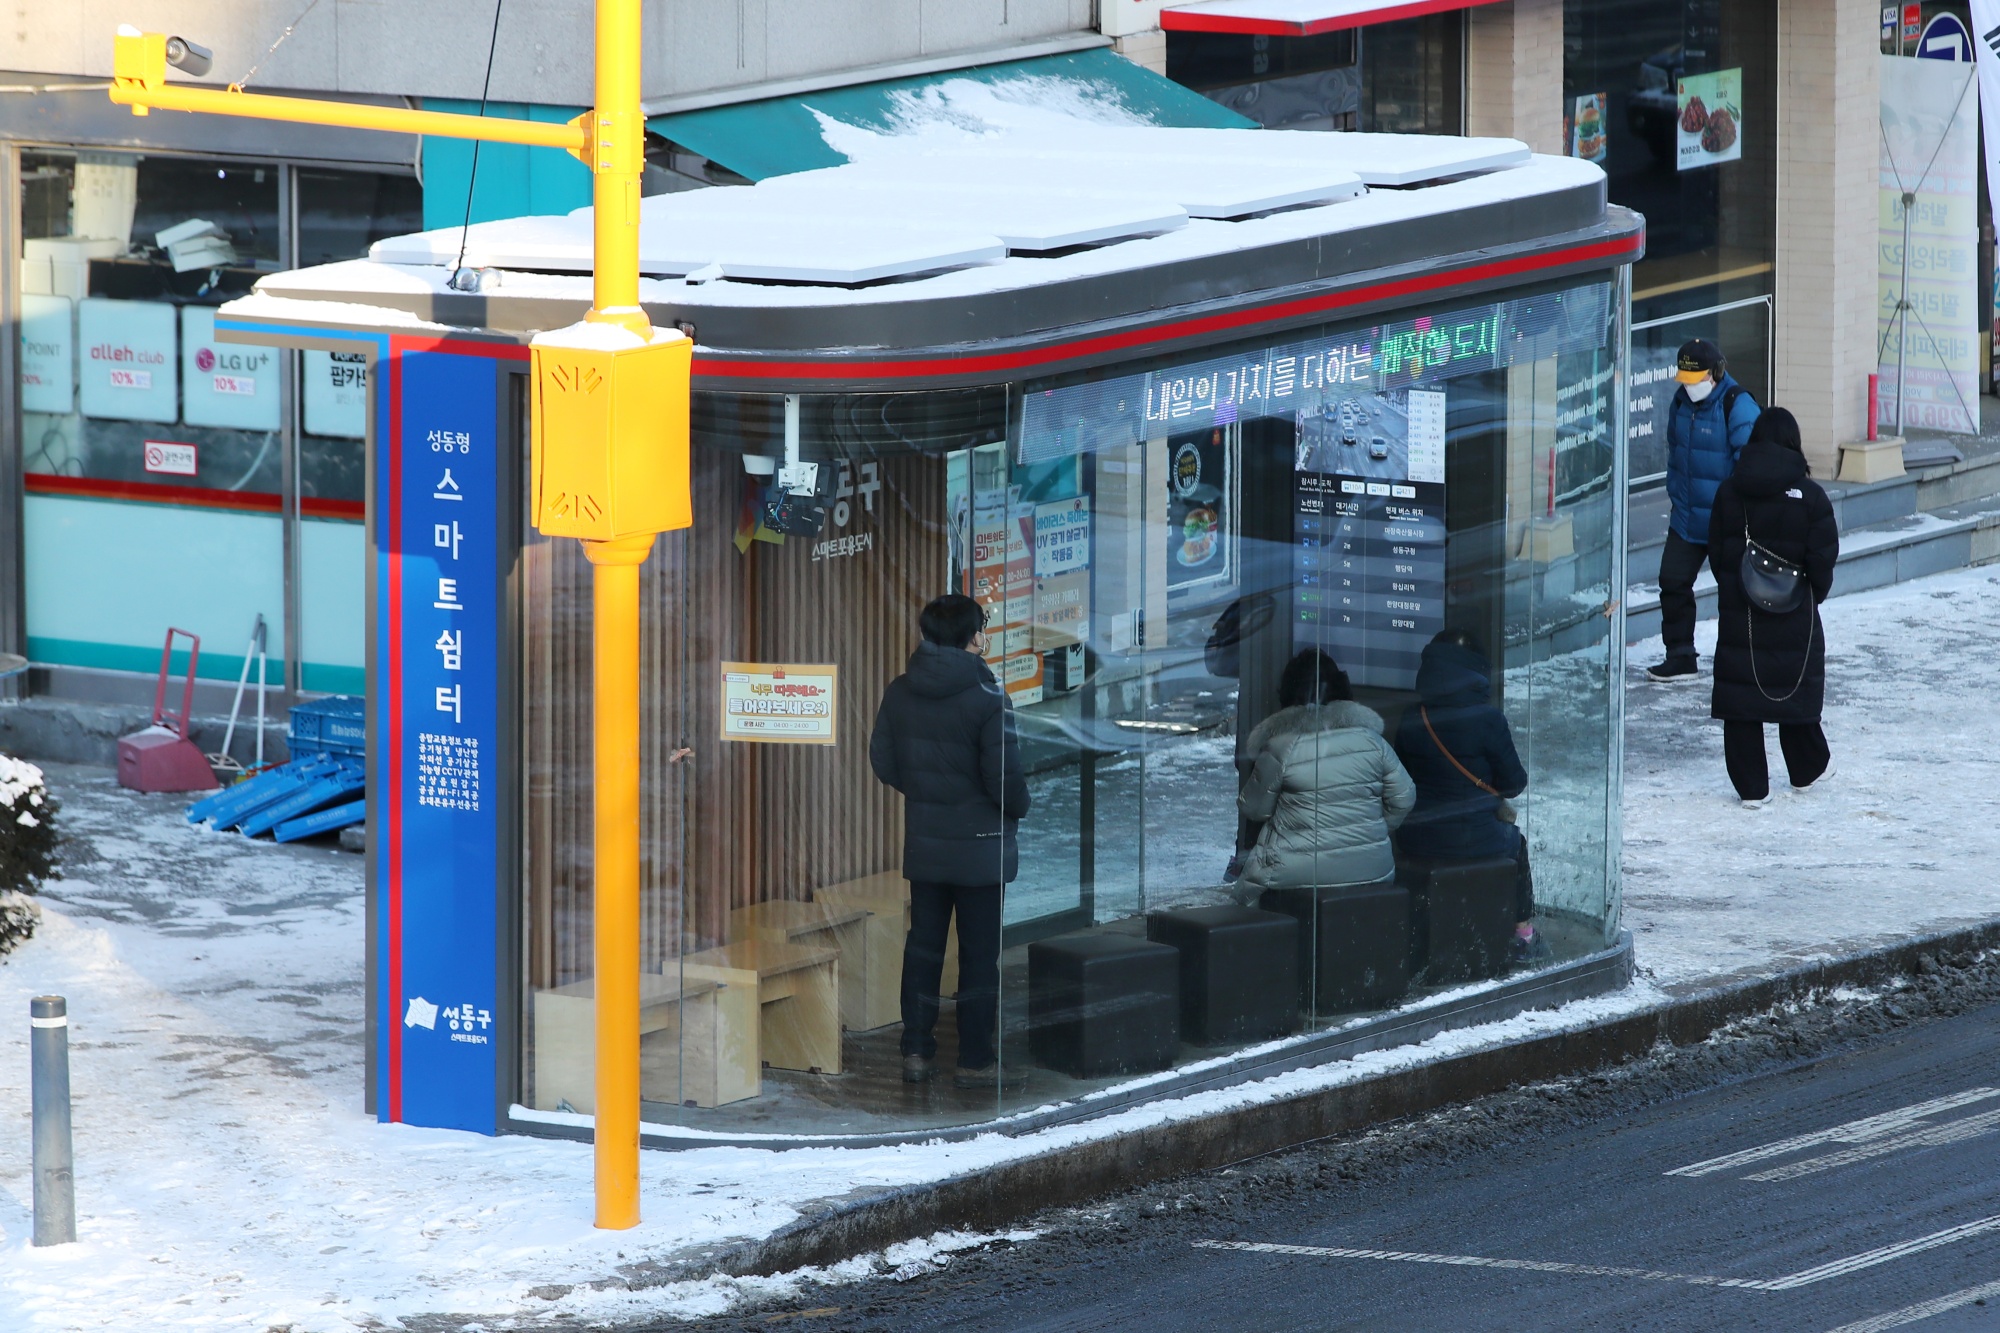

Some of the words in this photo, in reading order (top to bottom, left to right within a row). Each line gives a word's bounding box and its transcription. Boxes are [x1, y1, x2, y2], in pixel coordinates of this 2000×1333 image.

[1885, 9, 1896, 20] VISA
[28, 343, 61, 357] POINT
[90, 344, 134, 362] alleh
[138, 351, 164, 364] club
[219, 354, 241, 370] LG
[246, 353, 269, 371] U+
[1147, 372, 1218, 421] 내일의
[1226, 356, 1295, 404] 가치를
[1302, 344, 1372, 389] 더하는
[1380, 326, 1451, 375] 쾌적한
[1452, 315, 1498, 360] 도시
[111, 372, 133, 385] 10%
[1634, 370, 1653, 386] family
[1654, 367, 1668, 381] from
[215, 378, 237, 391] 10%
[427, 429, 470, 454] 성동형
[1349, 483, 1362, 492] 110A
[1401, 488, 1411, 496] 421
[1336, 502, 1359, 512] 대기시간
[1385, 506, 1397, 515] 현재
[1398, 507, 1410, 516] 버스
[1412, 508, 1424, 517] 위치
[1036, 513, 1066, 531] 바이러스
[1067, 509, 1088, 524] 죽이는
[1036, 534, 1048, 550] UV
[1050, 529, 1065, 546] 공기
[1066, 526, 1088, 542] 살균기
[1384, 527, 1425, 538] 마장축산물시장
[812, 532, 872, 562] 스마트포용도시
[1393, 546, 1416, 556] 성동구청
[1051, 547, 1073, 563] 작동중
[1392, 582, 1416, 592] 왕십리역
[433, 468, 465, 723] 스마트쉼터
[1386, 600, 1421, 611] 한양대정문앞
[1392, 619, 1415, 629] 한양대앞
[751, 683, 773, 697] 너무
[729, 698, 829, 716] 들어와보세요:)
[419, 732, 462, 746] 종합교통정보
[463, 738, 479, 748] 제공
[419, 743, 450, 756] 공기청정
[455, 747, 479, 759] 냉난방
[419, 753, 443, 766] 자외선
[446, 756, 479, 769] 공기살균
[419, 785, 435, 796] 공공
[437, 787, 460, 797] Wi-Fi
[442, 1003, 492, 1032] 성동구
[450, 1033, 488, 1045] 스마트포용도시
